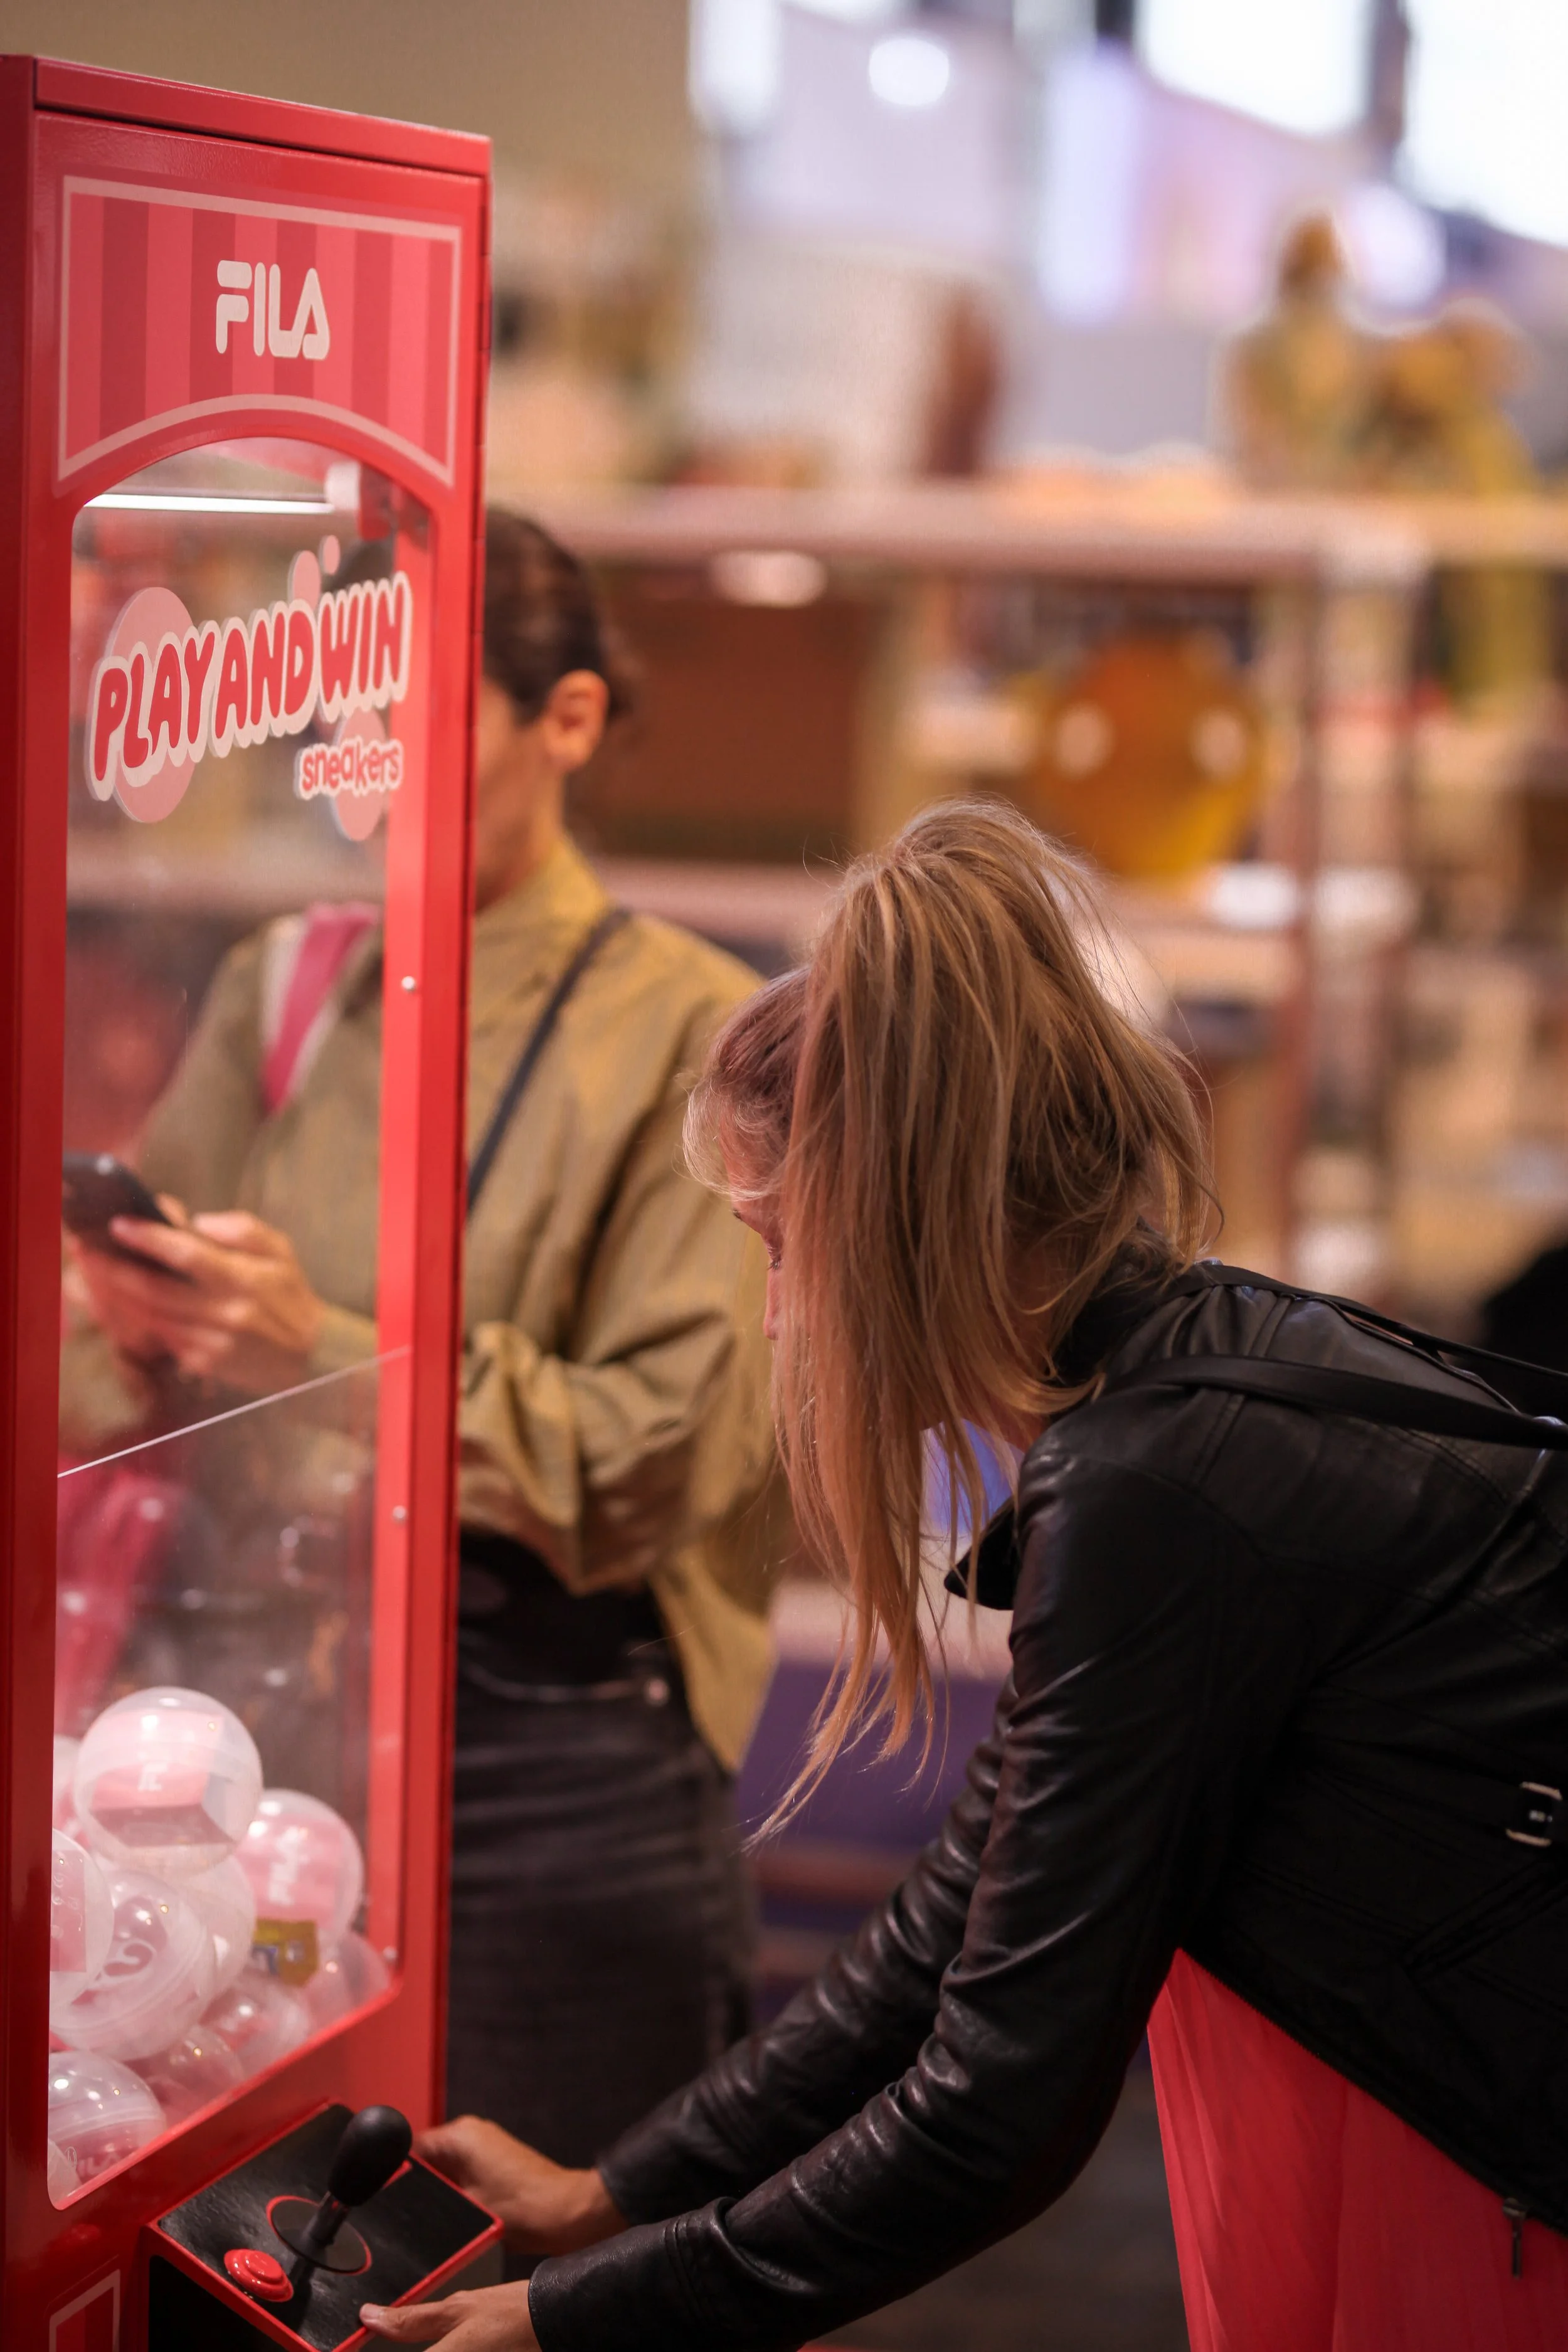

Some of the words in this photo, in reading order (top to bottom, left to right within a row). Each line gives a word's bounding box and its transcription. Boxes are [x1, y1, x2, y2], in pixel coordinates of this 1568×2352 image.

[216, 260, 330, 361] FILA
[93, 629, 216, 783] PLAY
[214, 608, 315, 741] AND
[319, 581, 405, 706] WIN
[302, 740, 400, 793] sneakers
